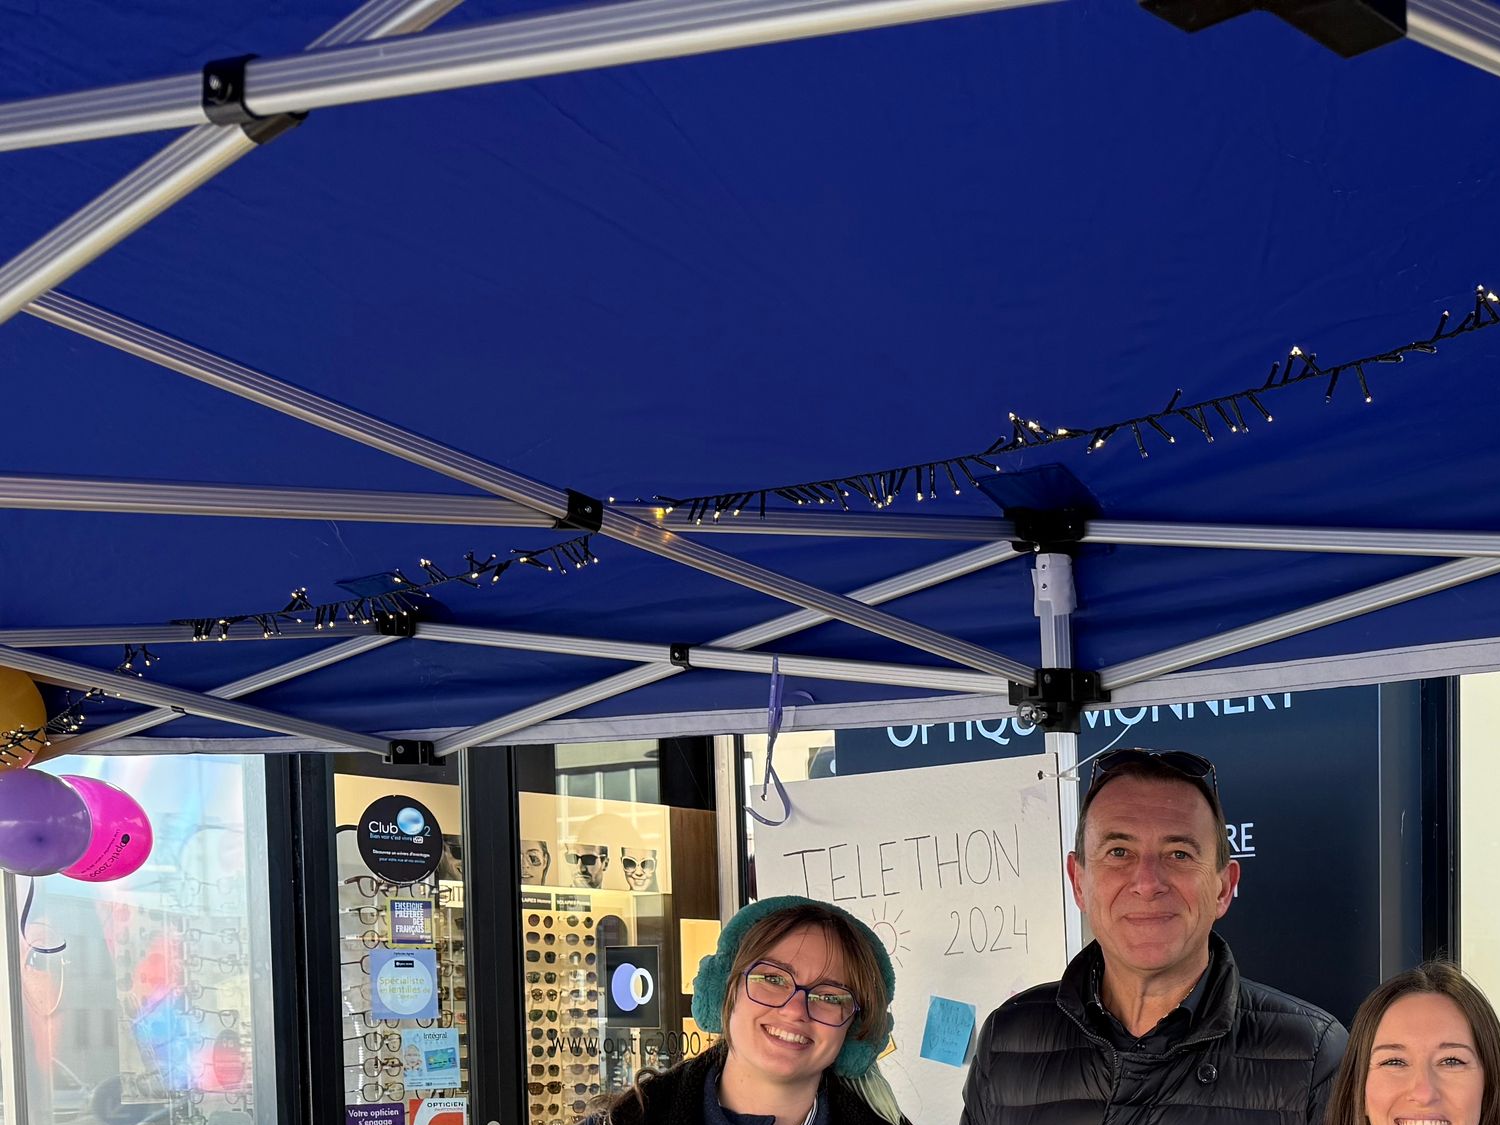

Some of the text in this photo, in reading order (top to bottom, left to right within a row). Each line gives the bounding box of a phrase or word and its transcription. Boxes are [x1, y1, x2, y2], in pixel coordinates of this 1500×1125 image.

[368, 821, 398, 834] Club
[783, 824, 1020, 901] TELETHON
[395, 902, 423, 910] ENSEIGNE
[413, 917, 424, 926] DES
[396, 924, 424, 934] FRANÇAIS
[944, 905, 1029, 954] 2024
[424, 1032, 447, 1040] Intégral
[348, 1107, 399, 1118] Votre opticien
